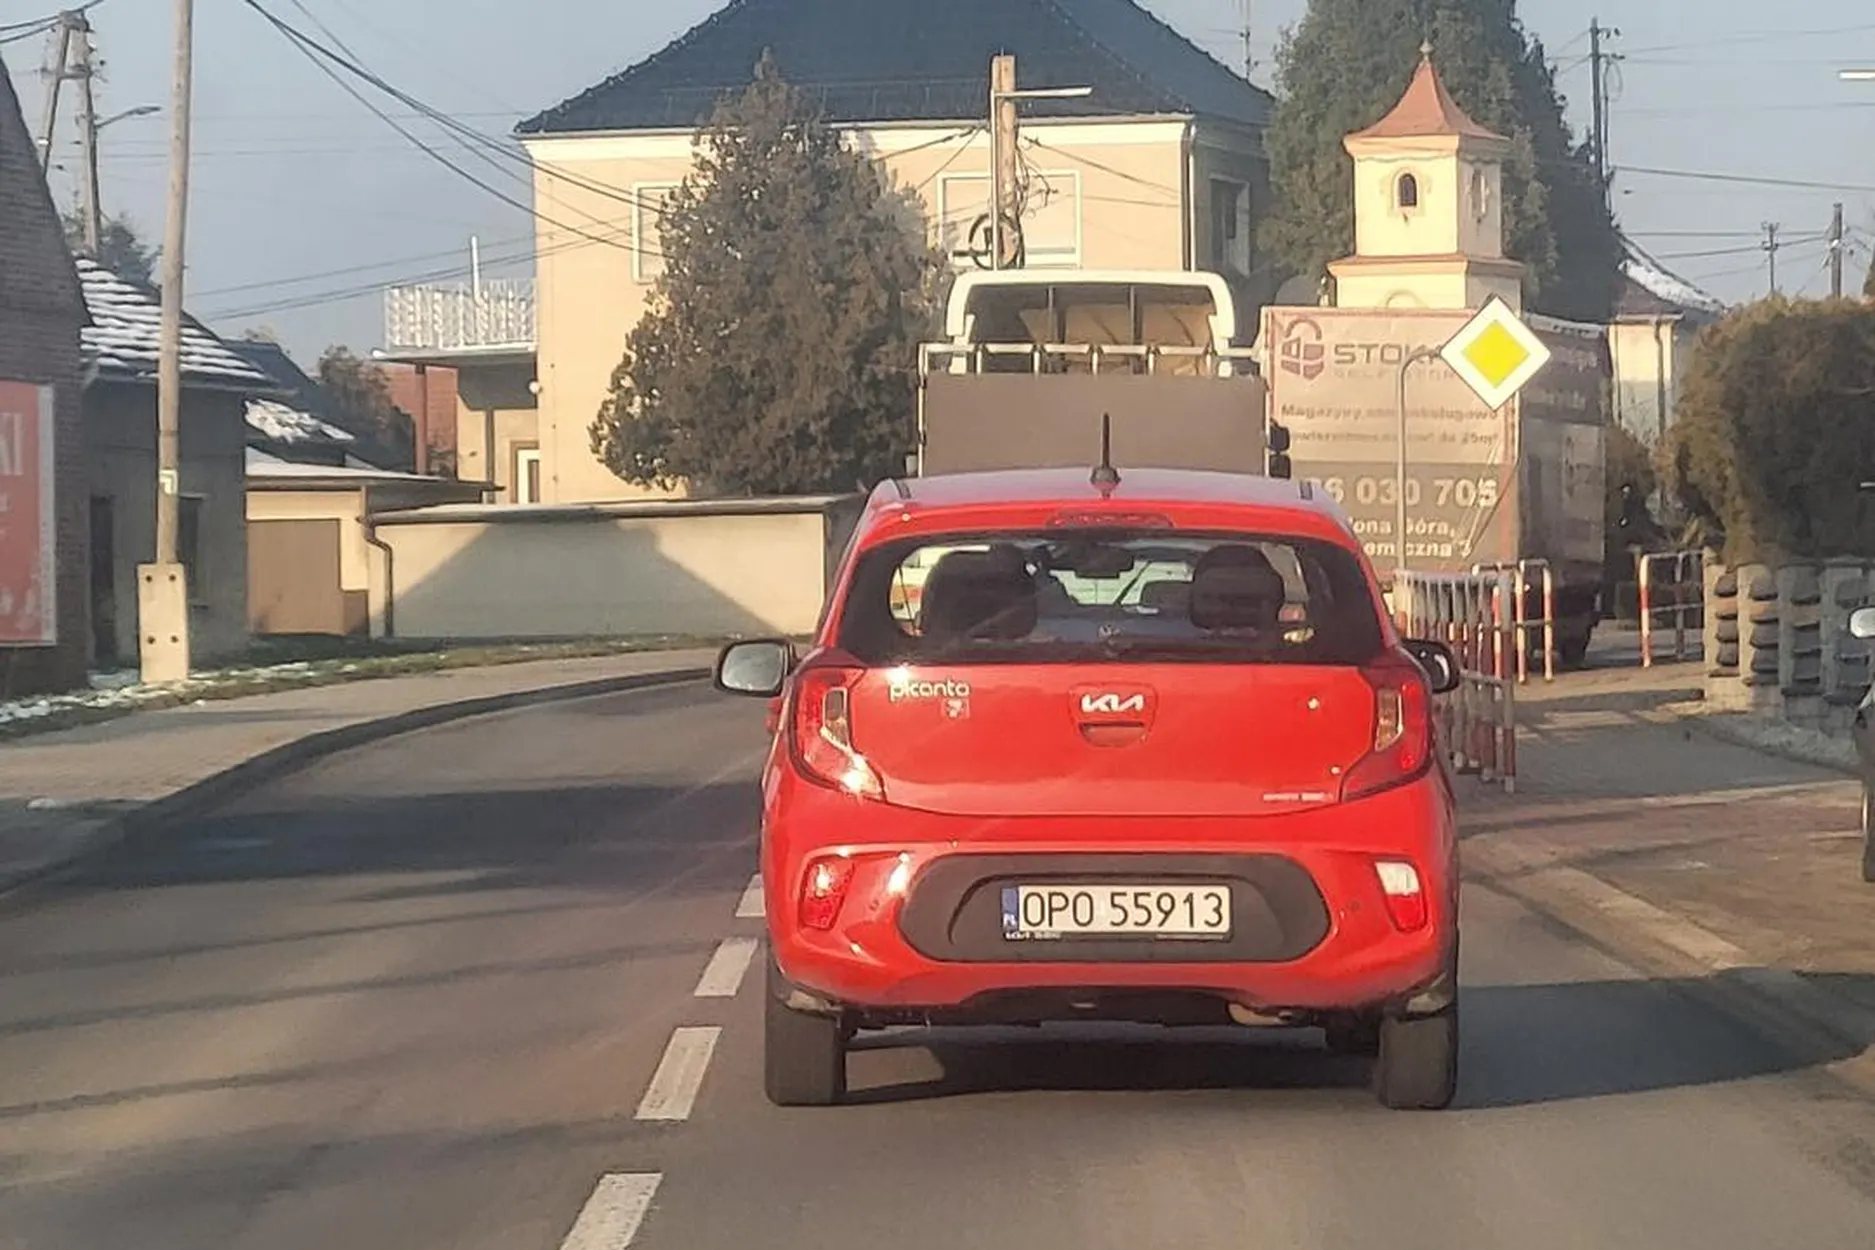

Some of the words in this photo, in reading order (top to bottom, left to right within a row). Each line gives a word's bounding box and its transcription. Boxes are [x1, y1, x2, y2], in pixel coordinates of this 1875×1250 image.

[1334, 343, 1441, 365] STOK
[1356, 477, 1421, 507] 030
[1346, 515, 1392, 534] ona
[1081, 694, 1144, 712] KIA
[1023, 891, 1094, 927] OPO
[1110, 891, 1223, 927] 55913
